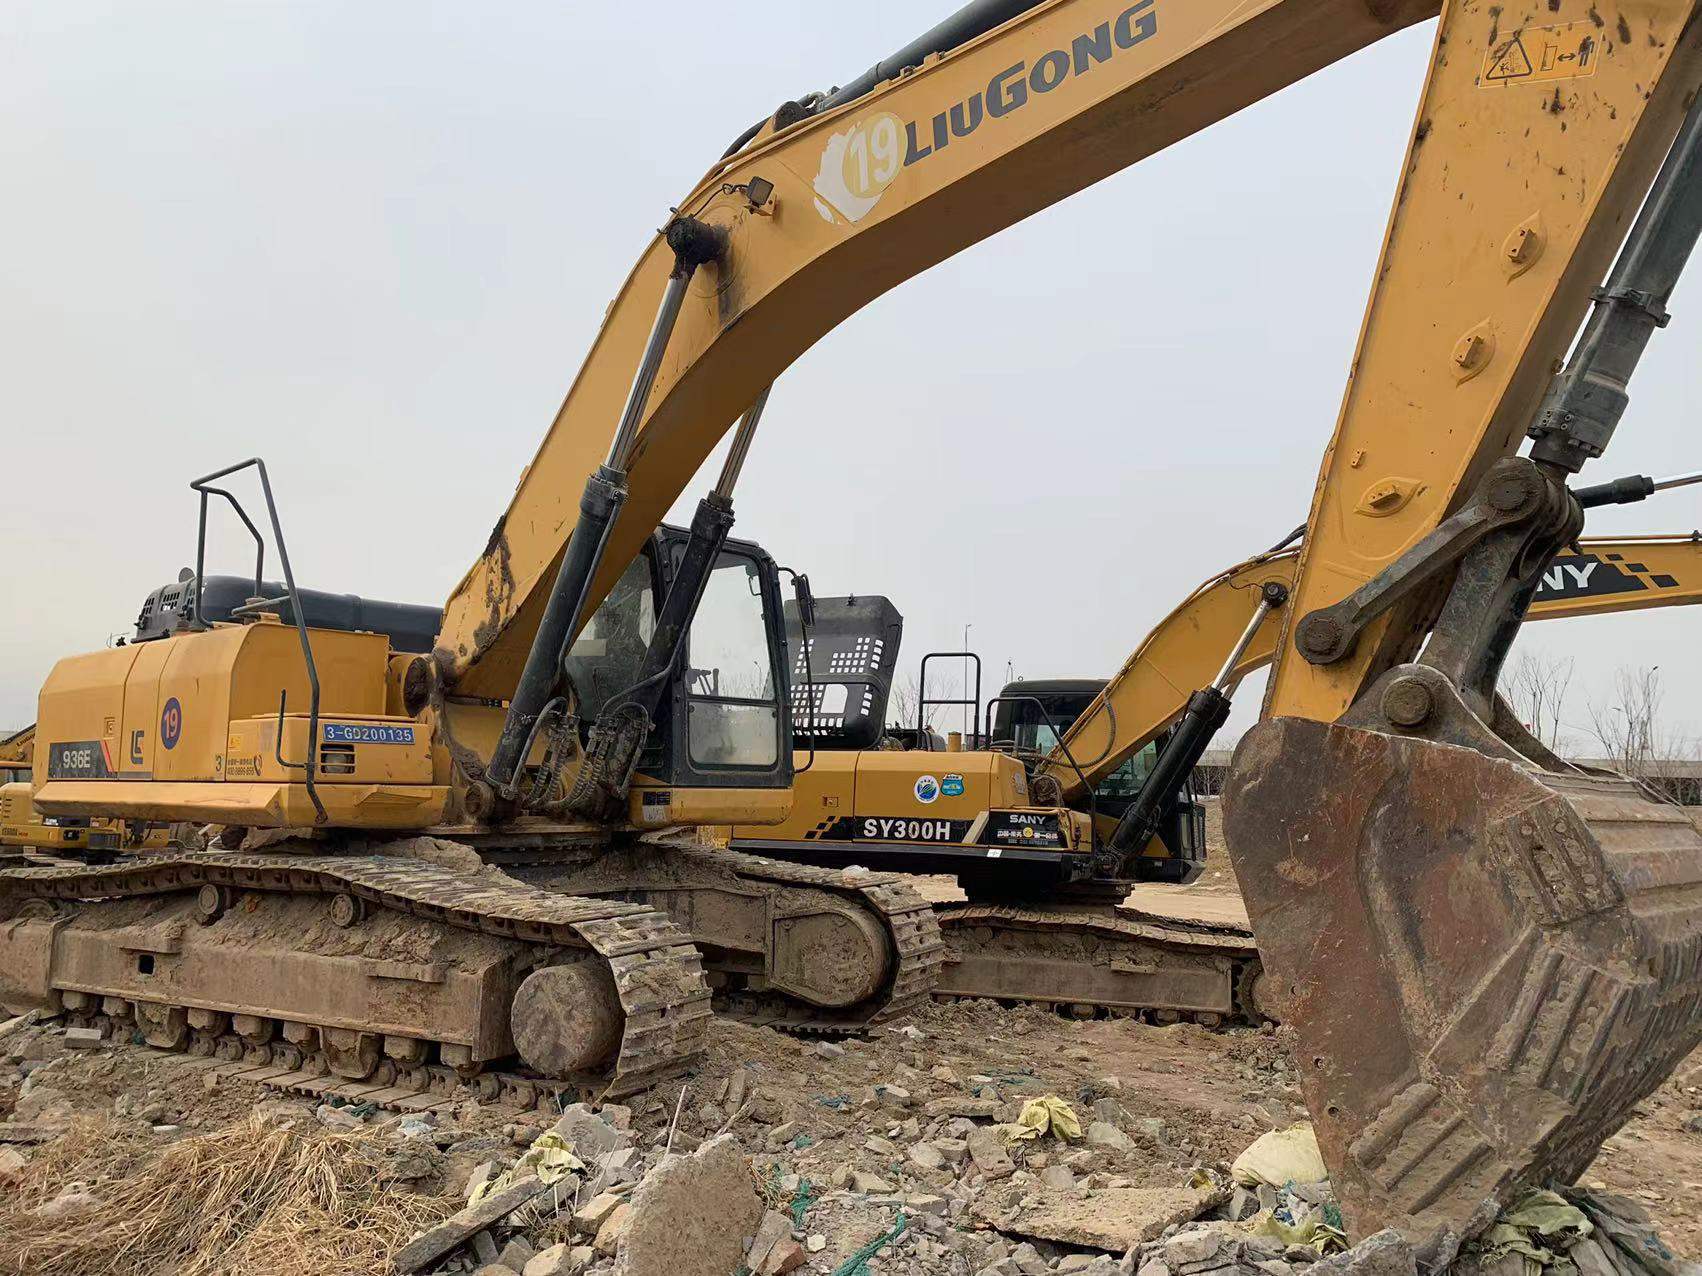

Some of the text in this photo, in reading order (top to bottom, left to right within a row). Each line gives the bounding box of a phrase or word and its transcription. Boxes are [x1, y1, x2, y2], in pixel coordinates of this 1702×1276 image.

[849, 0, 1158, 193] 19 LIUGONG
[327, 726, 412, 741] 3-GD200135
[63, 750, 91, 768] 936E
[1009, 814, 1046, 825] SANY
[863, 818, 951, 840] SY300H
